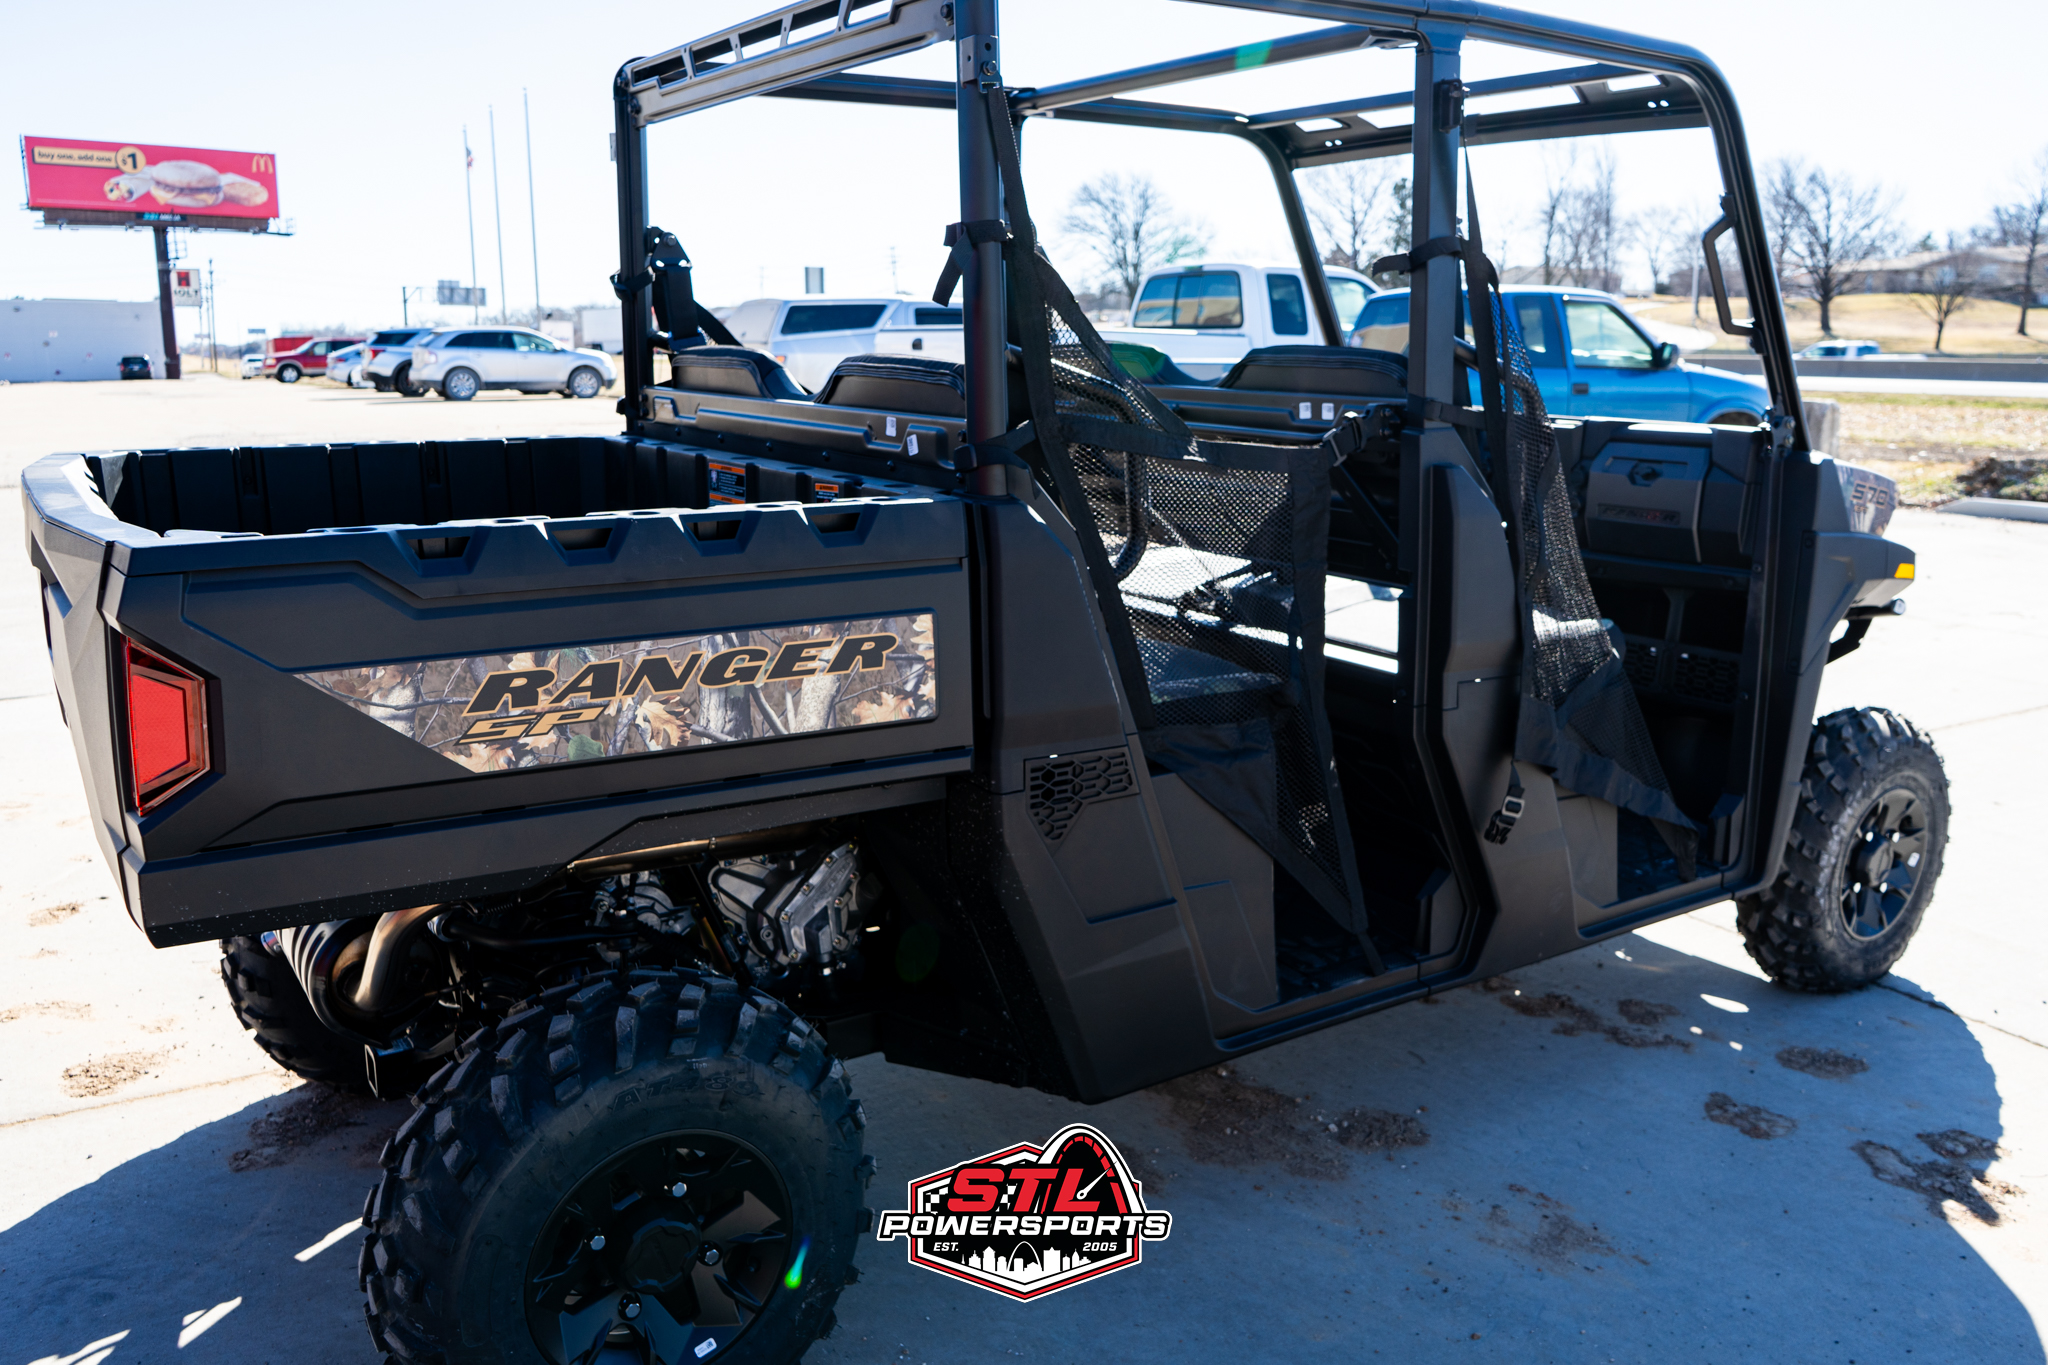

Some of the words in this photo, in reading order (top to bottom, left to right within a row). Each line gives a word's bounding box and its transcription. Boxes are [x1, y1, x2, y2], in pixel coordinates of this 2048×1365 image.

[38, 151, 54, 160] buy
[78, 153, 94, 161] add
[1851, 480, 1890, 509] 570
[461, 632, 899, 717] RANGER
[453, 705, 604, 746] SP
